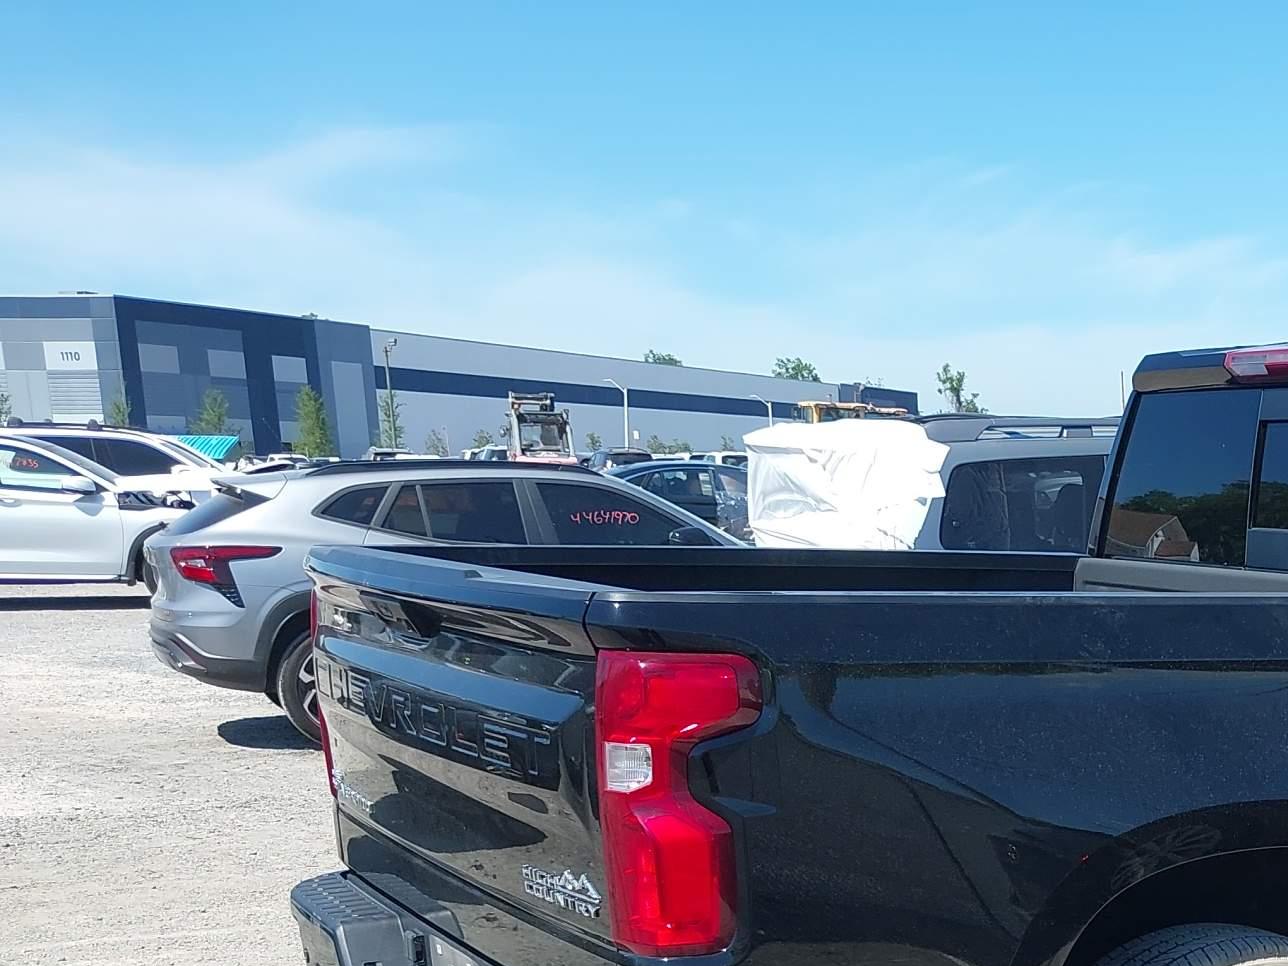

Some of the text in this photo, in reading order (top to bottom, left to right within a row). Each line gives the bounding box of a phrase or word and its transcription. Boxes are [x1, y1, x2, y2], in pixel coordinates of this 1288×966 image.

[60, 351, 81, 361] 1110
[314, 655, 551, 777] CHEVROLET
[522, 864, 561, 890] HIGH
[524, 880, 601, 919] COUNTRY
